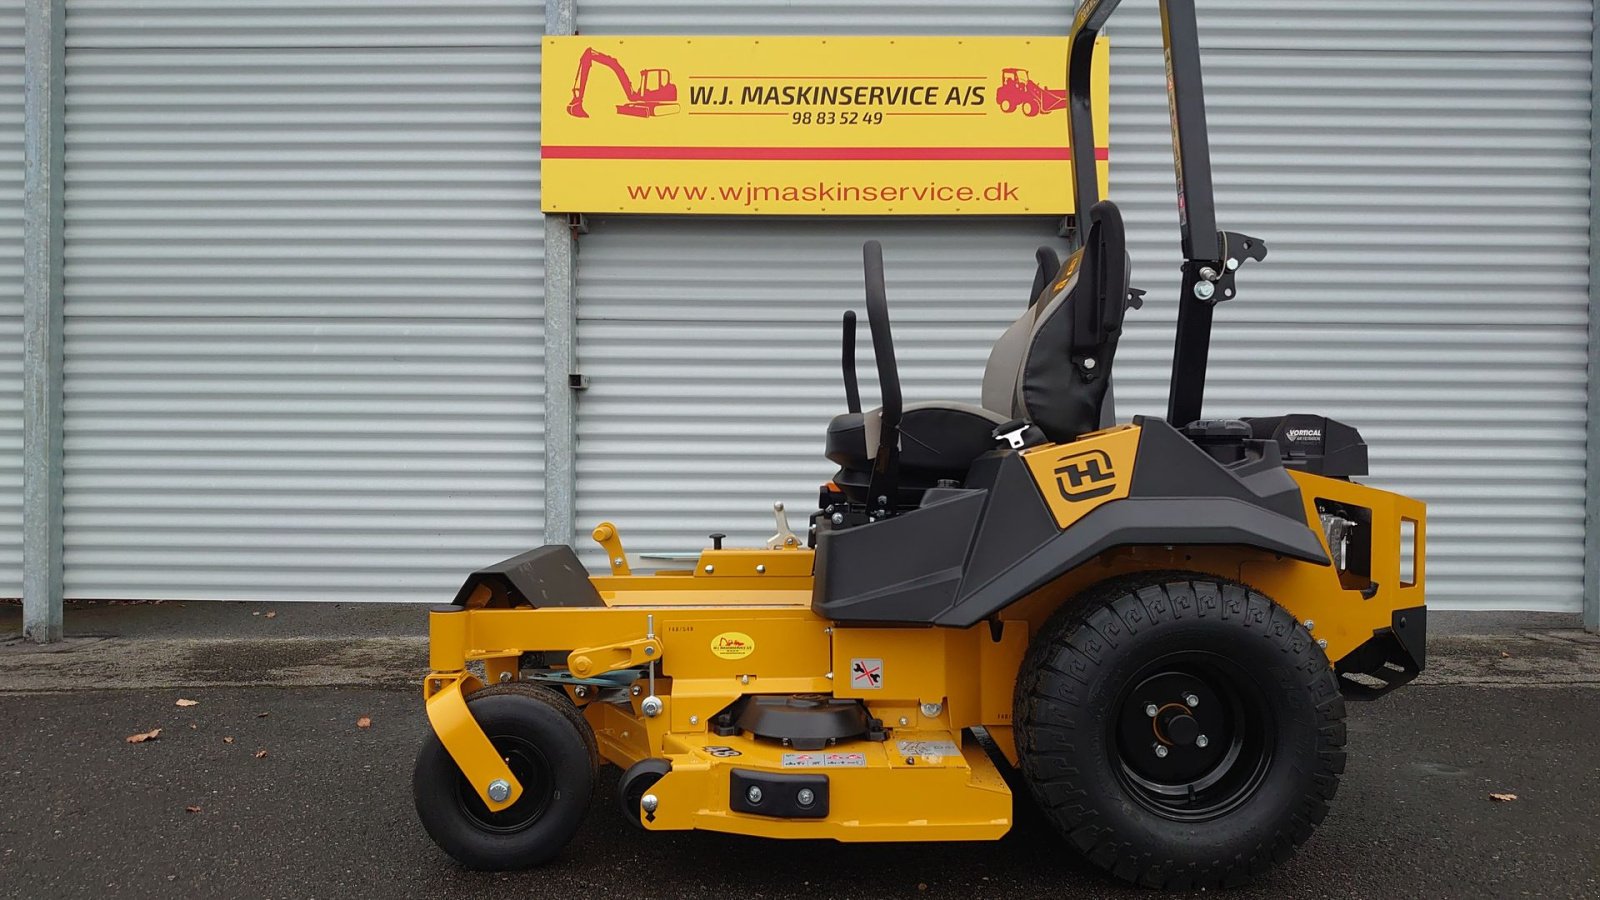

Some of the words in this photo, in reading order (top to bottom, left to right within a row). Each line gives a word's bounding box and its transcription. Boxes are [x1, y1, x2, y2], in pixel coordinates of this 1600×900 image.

[690, 86, 733, 106] W.J.
[741, 86, 938, 106] MASKINSERVICE
[945, 86, 985, 106] A/S
[792, 112, 812, 125] 98
[816, 112, 836, 125] 83
[840, 112, 859, 125] 52
[863, 112, 883, 125] 49
[627, 182, 1019, 206] www.wjmaskinservice.dk
